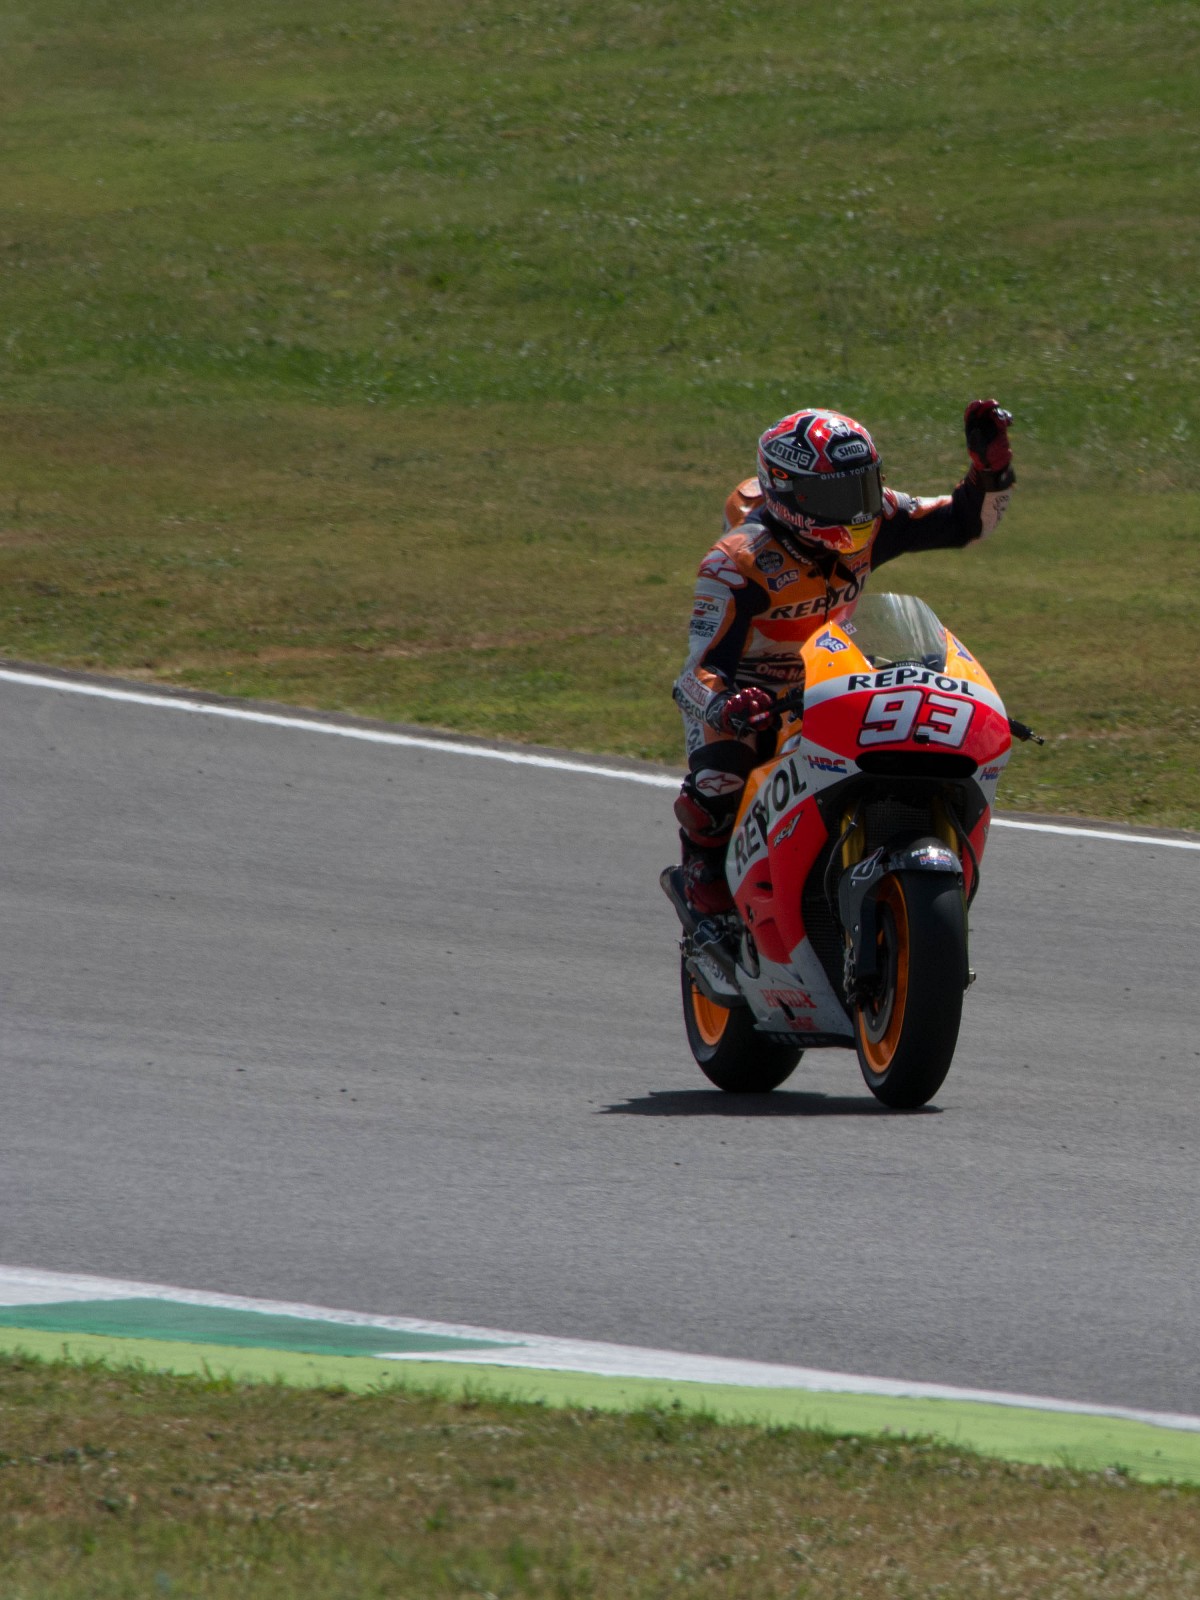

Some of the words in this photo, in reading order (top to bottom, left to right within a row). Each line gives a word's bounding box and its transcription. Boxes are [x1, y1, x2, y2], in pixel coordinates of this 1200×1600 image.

[772, 441, 811, 467] LOTUS
[839, 444, 865, 457] SHOEI
[776, 571, 798, 589] GAS
[755, 662, 786, 679] One
[848, 668, 975, 697] REPSOL
[858, 689, 976, 750] 93
[808, 755, 848, 774] HRC
